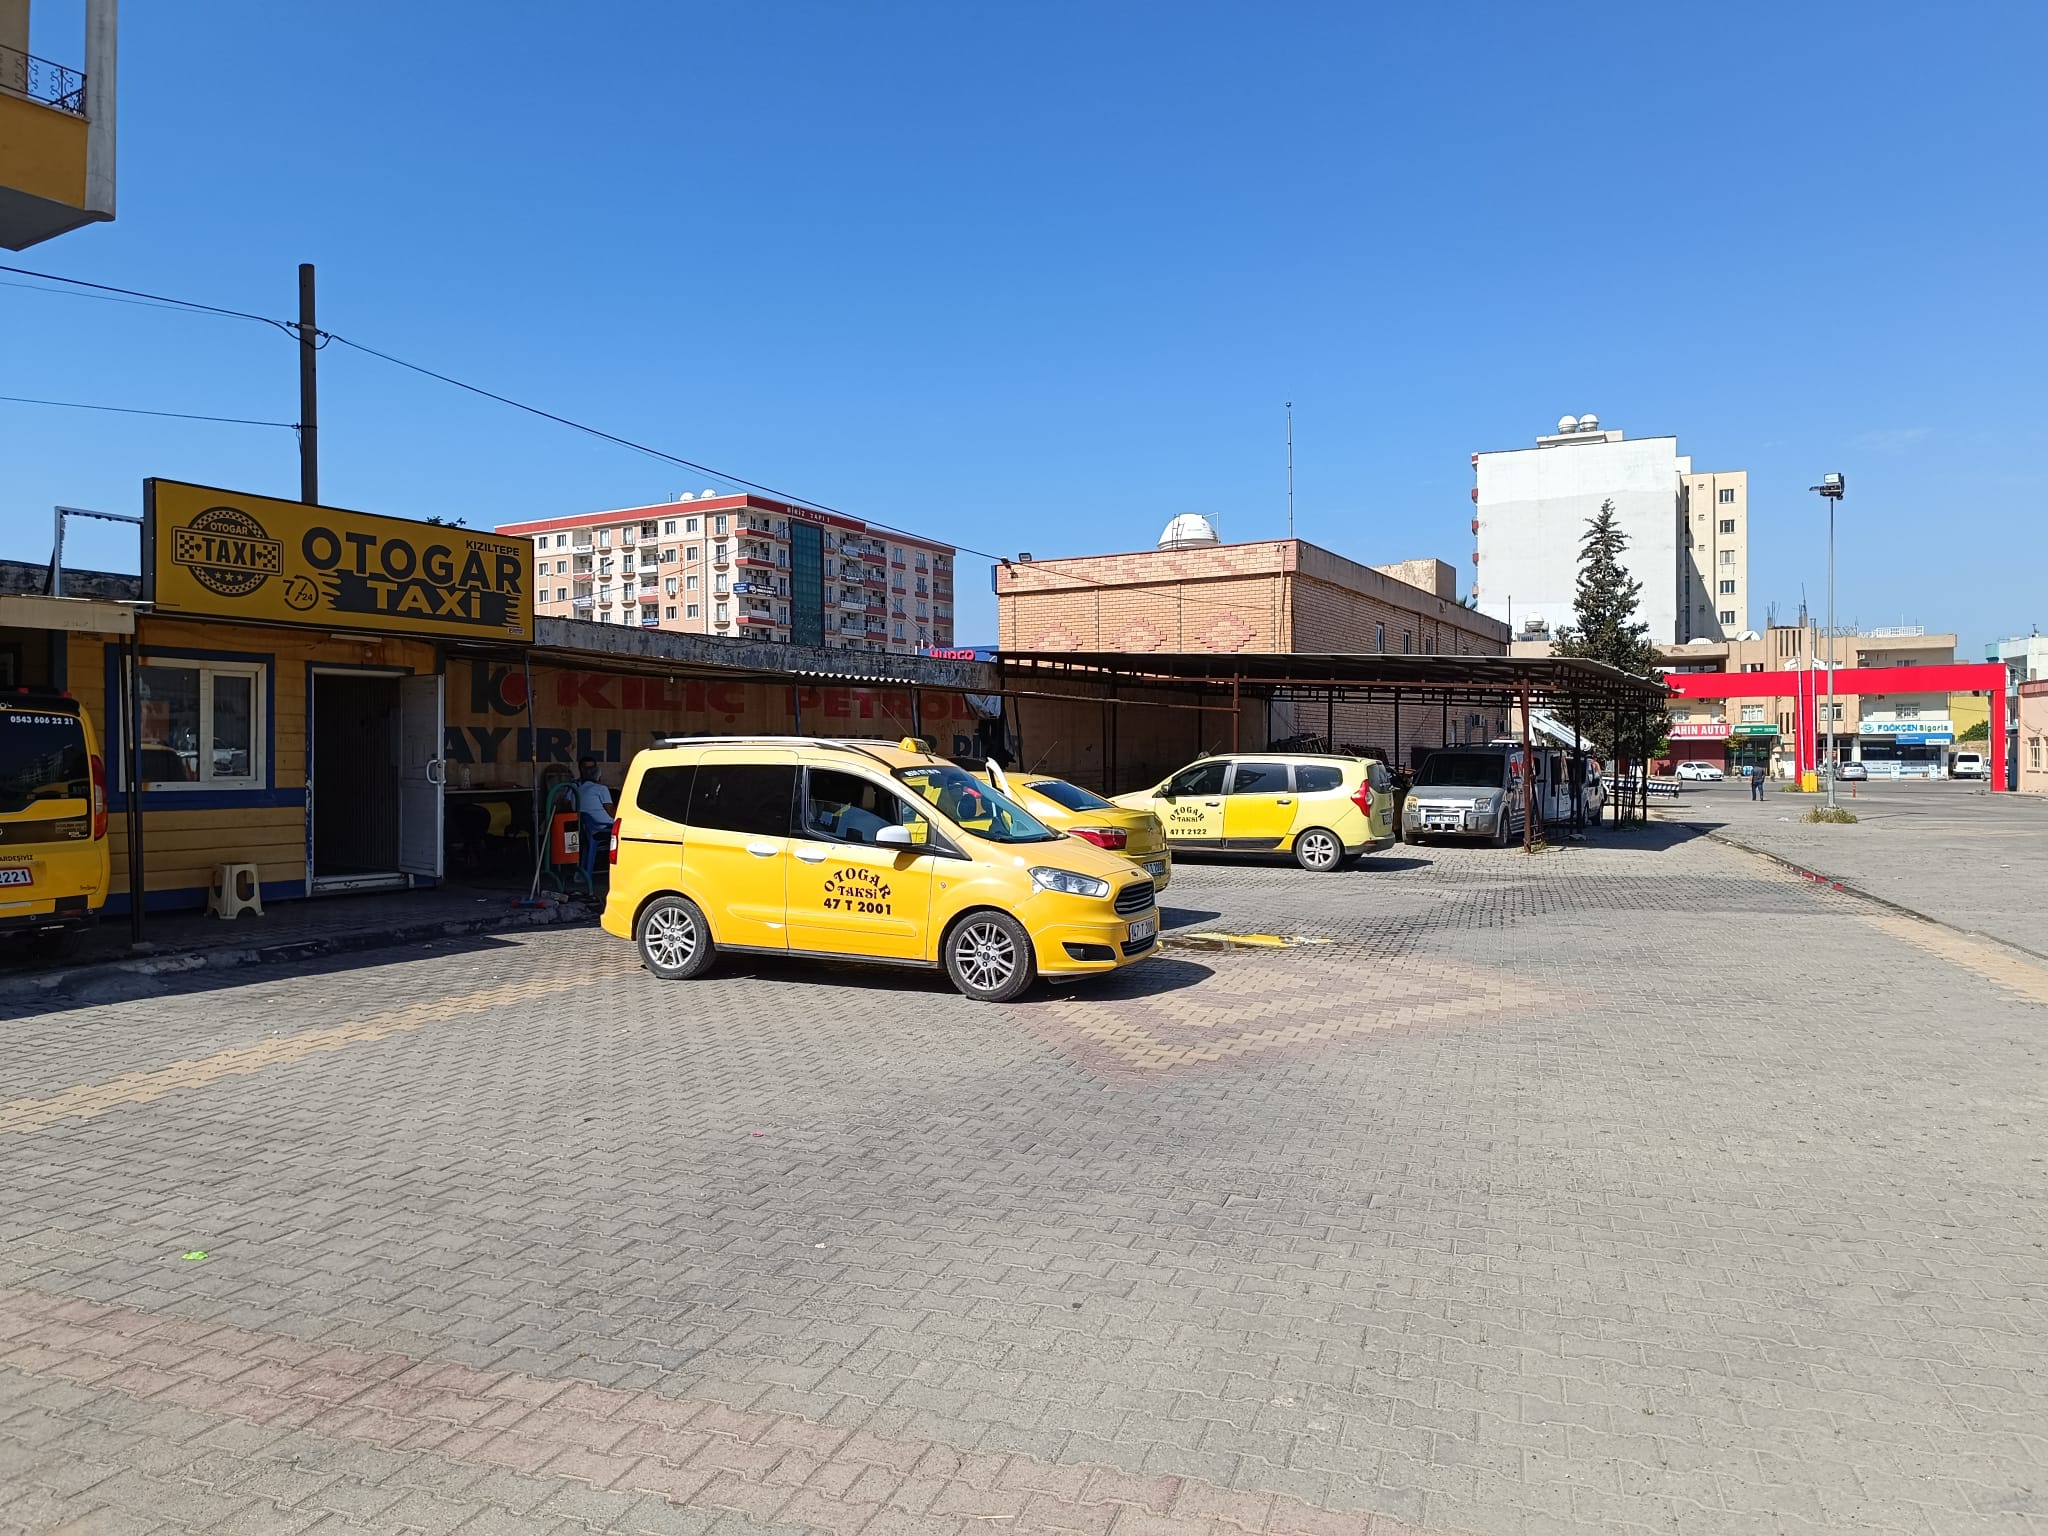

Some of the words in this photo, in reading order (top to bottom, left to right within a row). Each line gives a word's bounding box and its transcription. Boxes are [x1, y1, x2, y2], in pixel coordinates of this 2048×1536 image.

[209, 521, 249, 537] OTOGAR
[201, 536, 257, 567] TAXI
[465, 539, 520, 557] KIZILTEPE
[302, 526, 522, 594] OTOGAR
[785, 684, 977, 721] PETROL
[10, 715, 32, 724] 0543
[34, 716, 50, 724] 606
[52, 717, 63, 725] 22
[64, 718, 74, 726] 21
[1701, 725, 1726, 735] AUTO
[1169, 806, 1205, 822] OTOGAR
[823, 867, 892, 900] OTOGAR
[823, 897, 841, 910] 47
[845, 899, 853, 911] T
[857, 900, 892, 916] 2001
